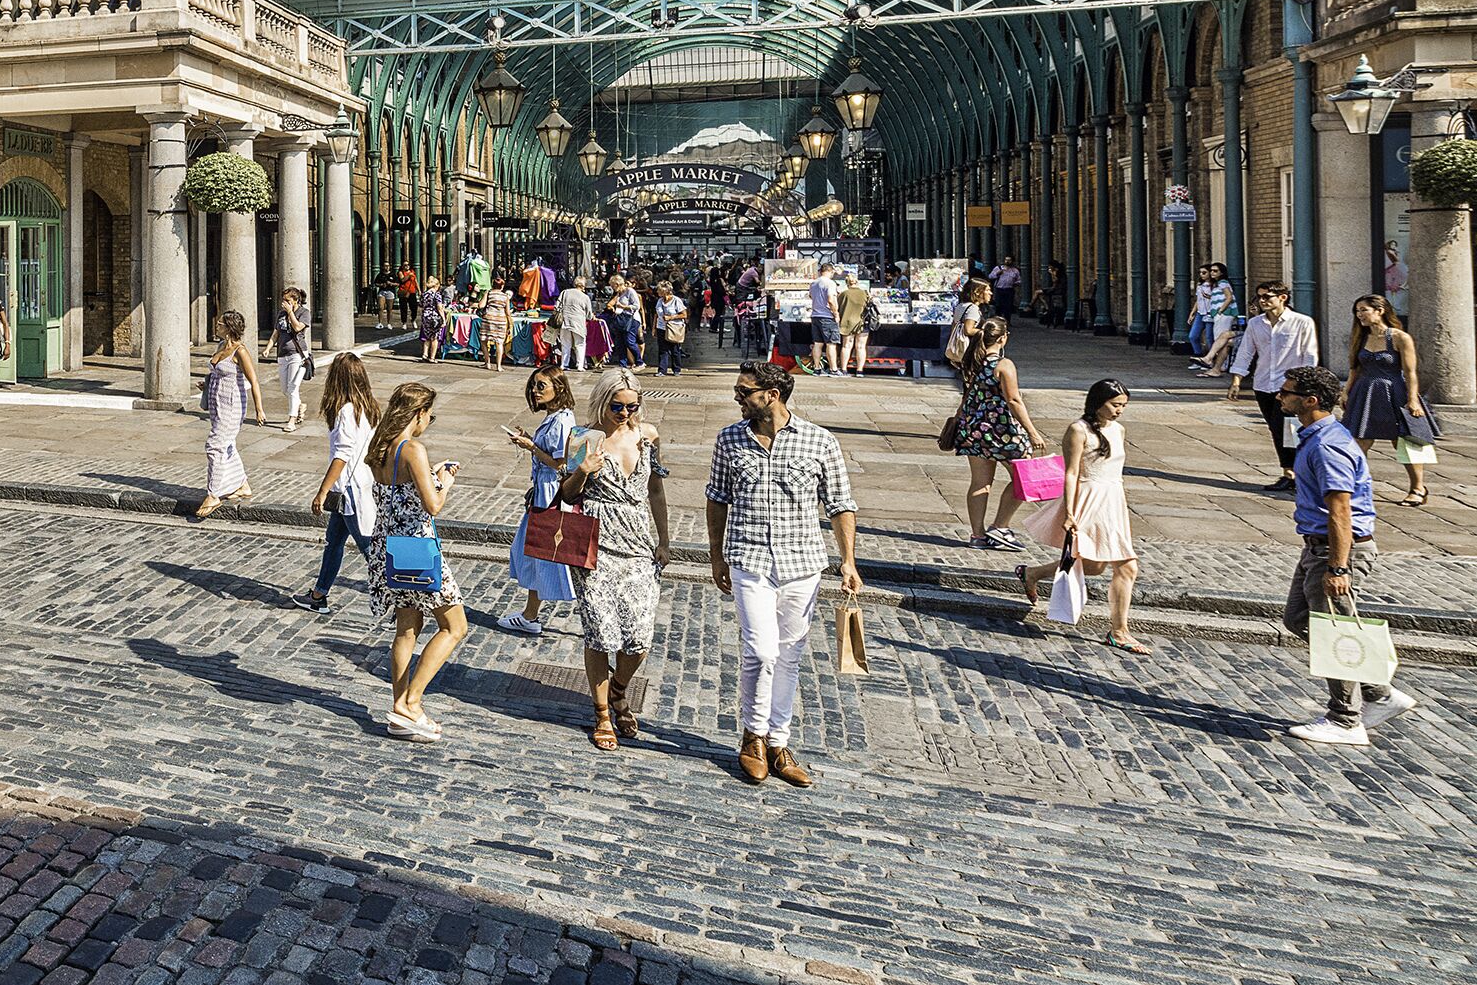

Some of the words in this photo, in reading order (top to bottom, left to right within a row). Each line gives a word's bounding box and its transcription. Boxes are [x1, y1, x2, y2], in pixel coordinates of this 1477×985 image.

[616, 169, 663, 188] APPLE
[671, 167, 744, 185] MARKET
[658, 200, 688, 212] APPLE
[695, 200, 741, 212] MARKET
